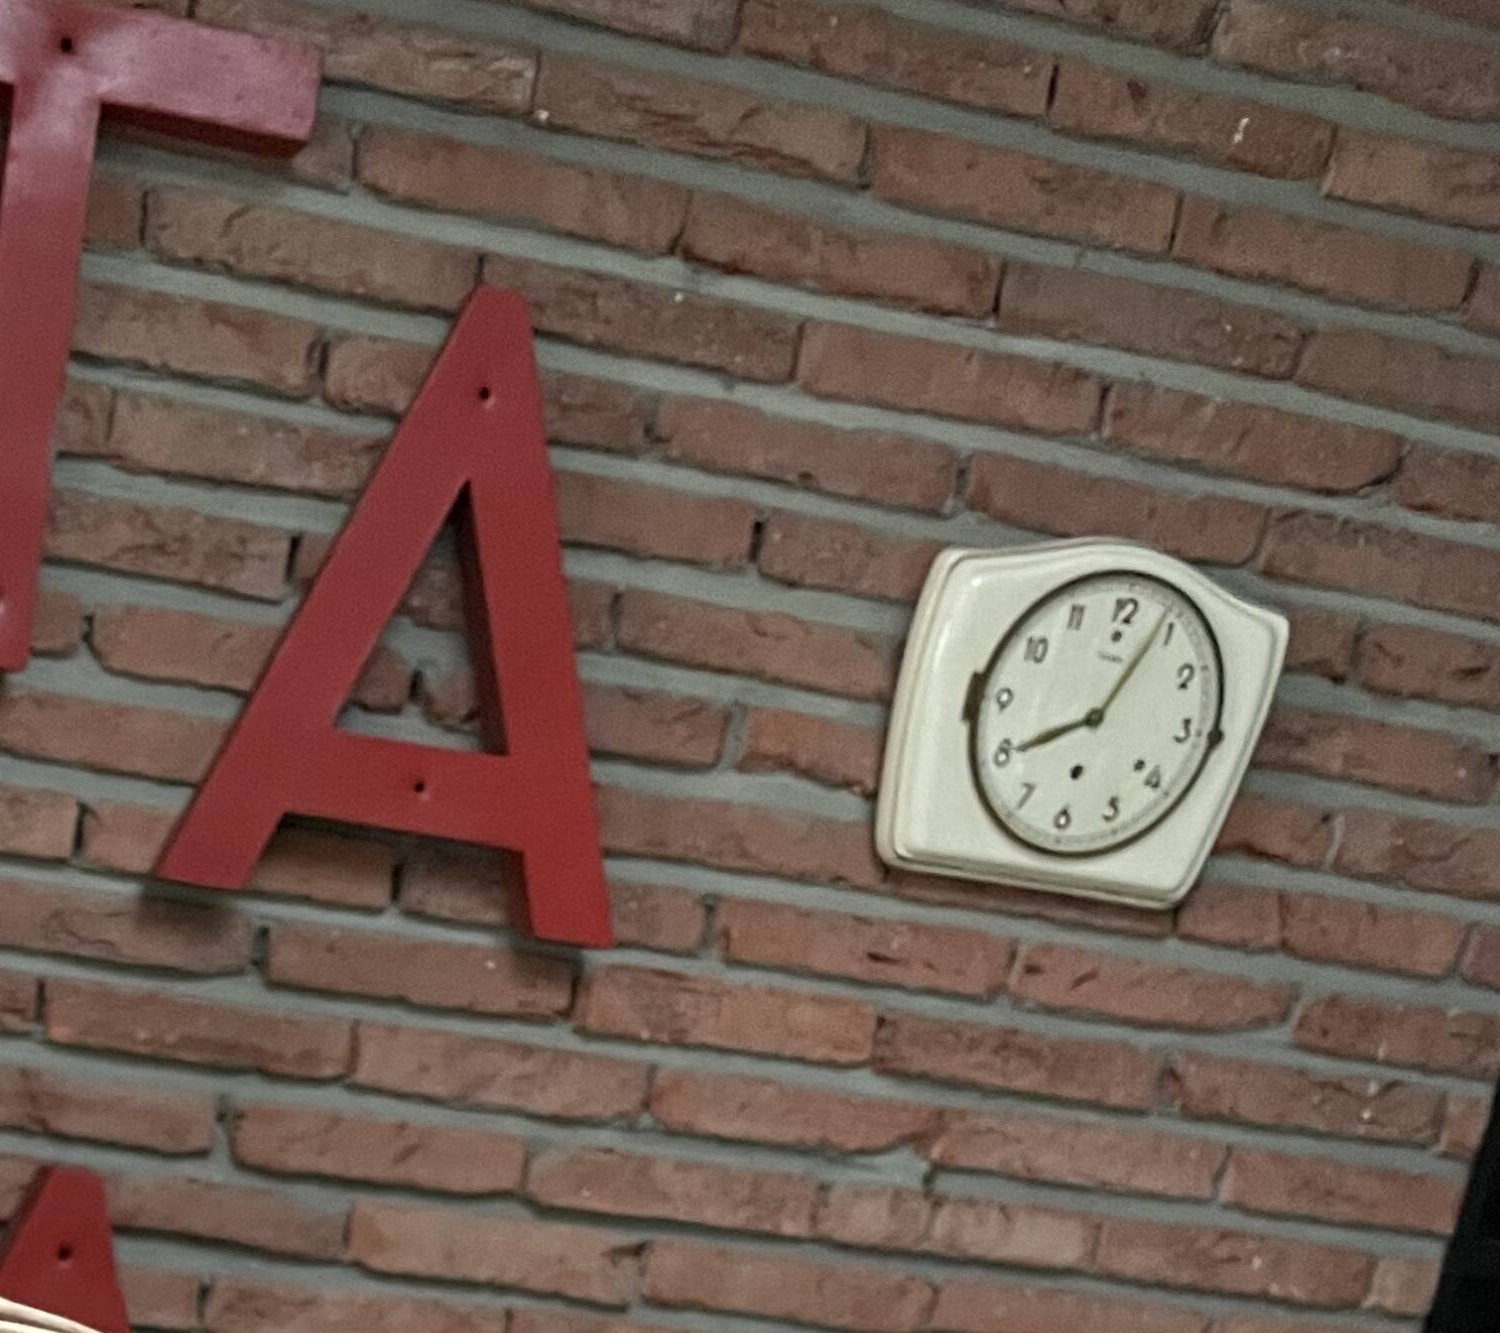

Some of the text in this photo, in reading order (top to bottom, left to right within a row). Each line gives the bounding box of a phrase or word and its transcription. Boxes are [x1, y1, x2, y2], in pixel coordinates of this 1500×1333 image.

[156, 282, 616, 948] A
[1067, 604, 1087, 630] 11
[1111, 598, 1141, 626] 12
[1163, 623, 1176, 646] 1
[1023, 636, 1050, 663] 10
[1176, 664, 1196, 689] 2
[996, 687, 1015, 710] 9
[1174, 718, 1193, 744] 3
[1014, 783, 1037, 809] 7
[1102, 796, 1120, 822] 5
[1053, 806, 1072, 829] 6
